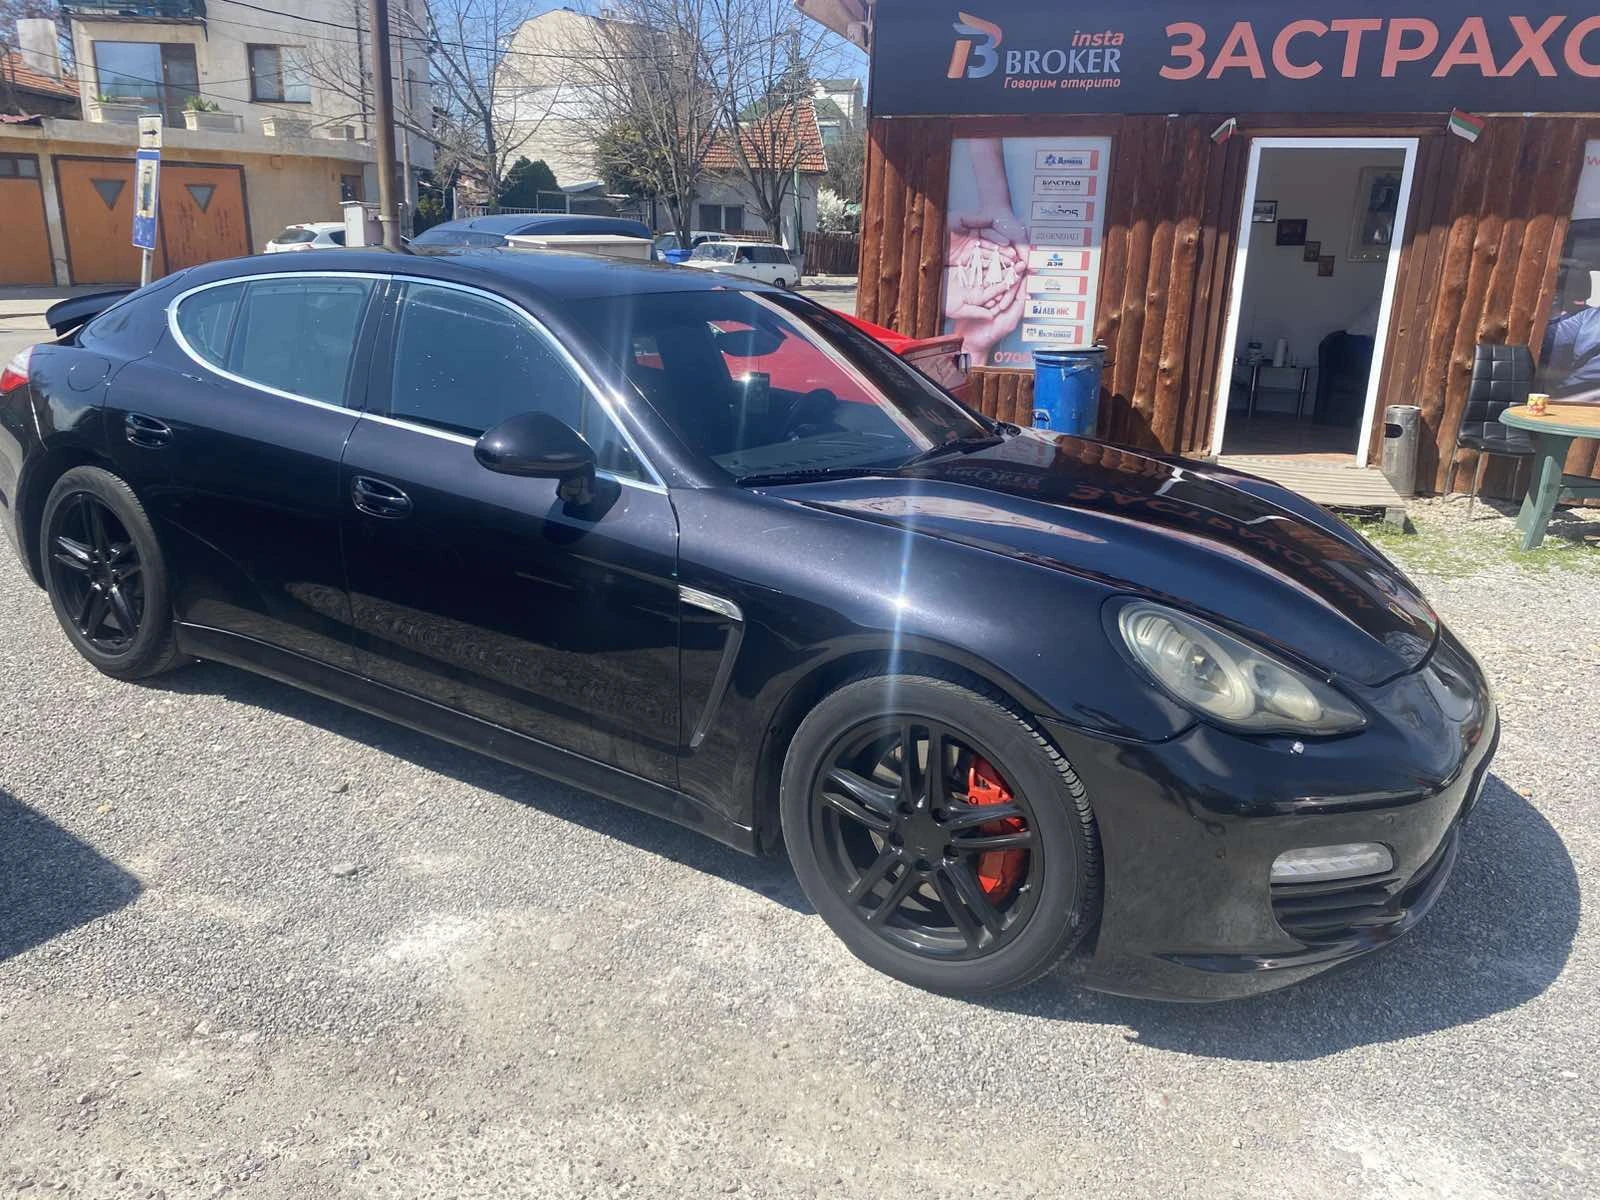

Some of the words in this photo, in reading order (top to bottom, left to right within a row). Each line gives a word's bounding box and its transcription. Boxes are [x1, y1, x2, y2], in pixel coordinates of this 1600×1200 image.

[1072, 30, 1125, 46] insta
[1005, 49, 1121, 75] BROKER
[1004, 77, 1056, 91] Говорим
[1061, 77, 1121, 91] открито
